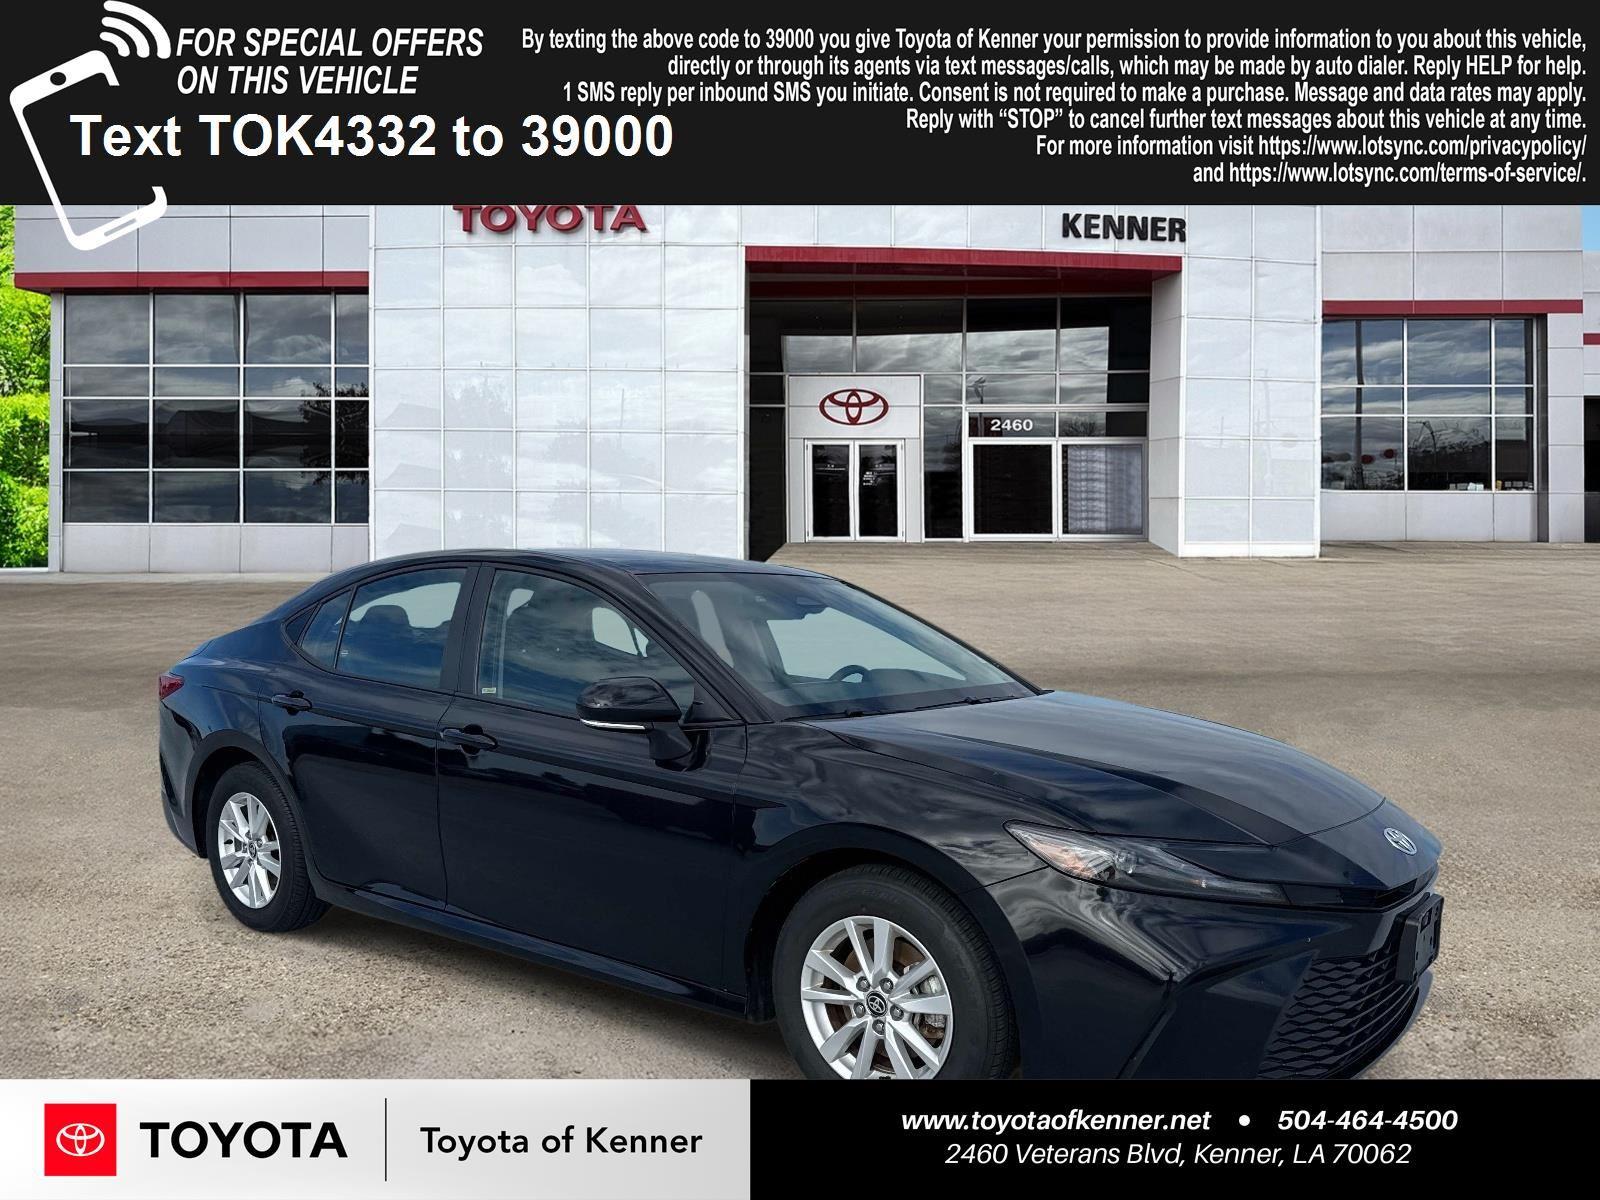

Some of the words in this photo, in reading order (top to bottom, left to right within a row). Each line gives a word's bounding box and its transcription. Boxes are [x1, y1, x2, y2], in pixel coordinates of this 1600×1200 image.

[453, 205, 649, 232] TOYOTA
[1062, 213, 1187, 242] KENNER
[990, 418, 1034, 432] 2460
